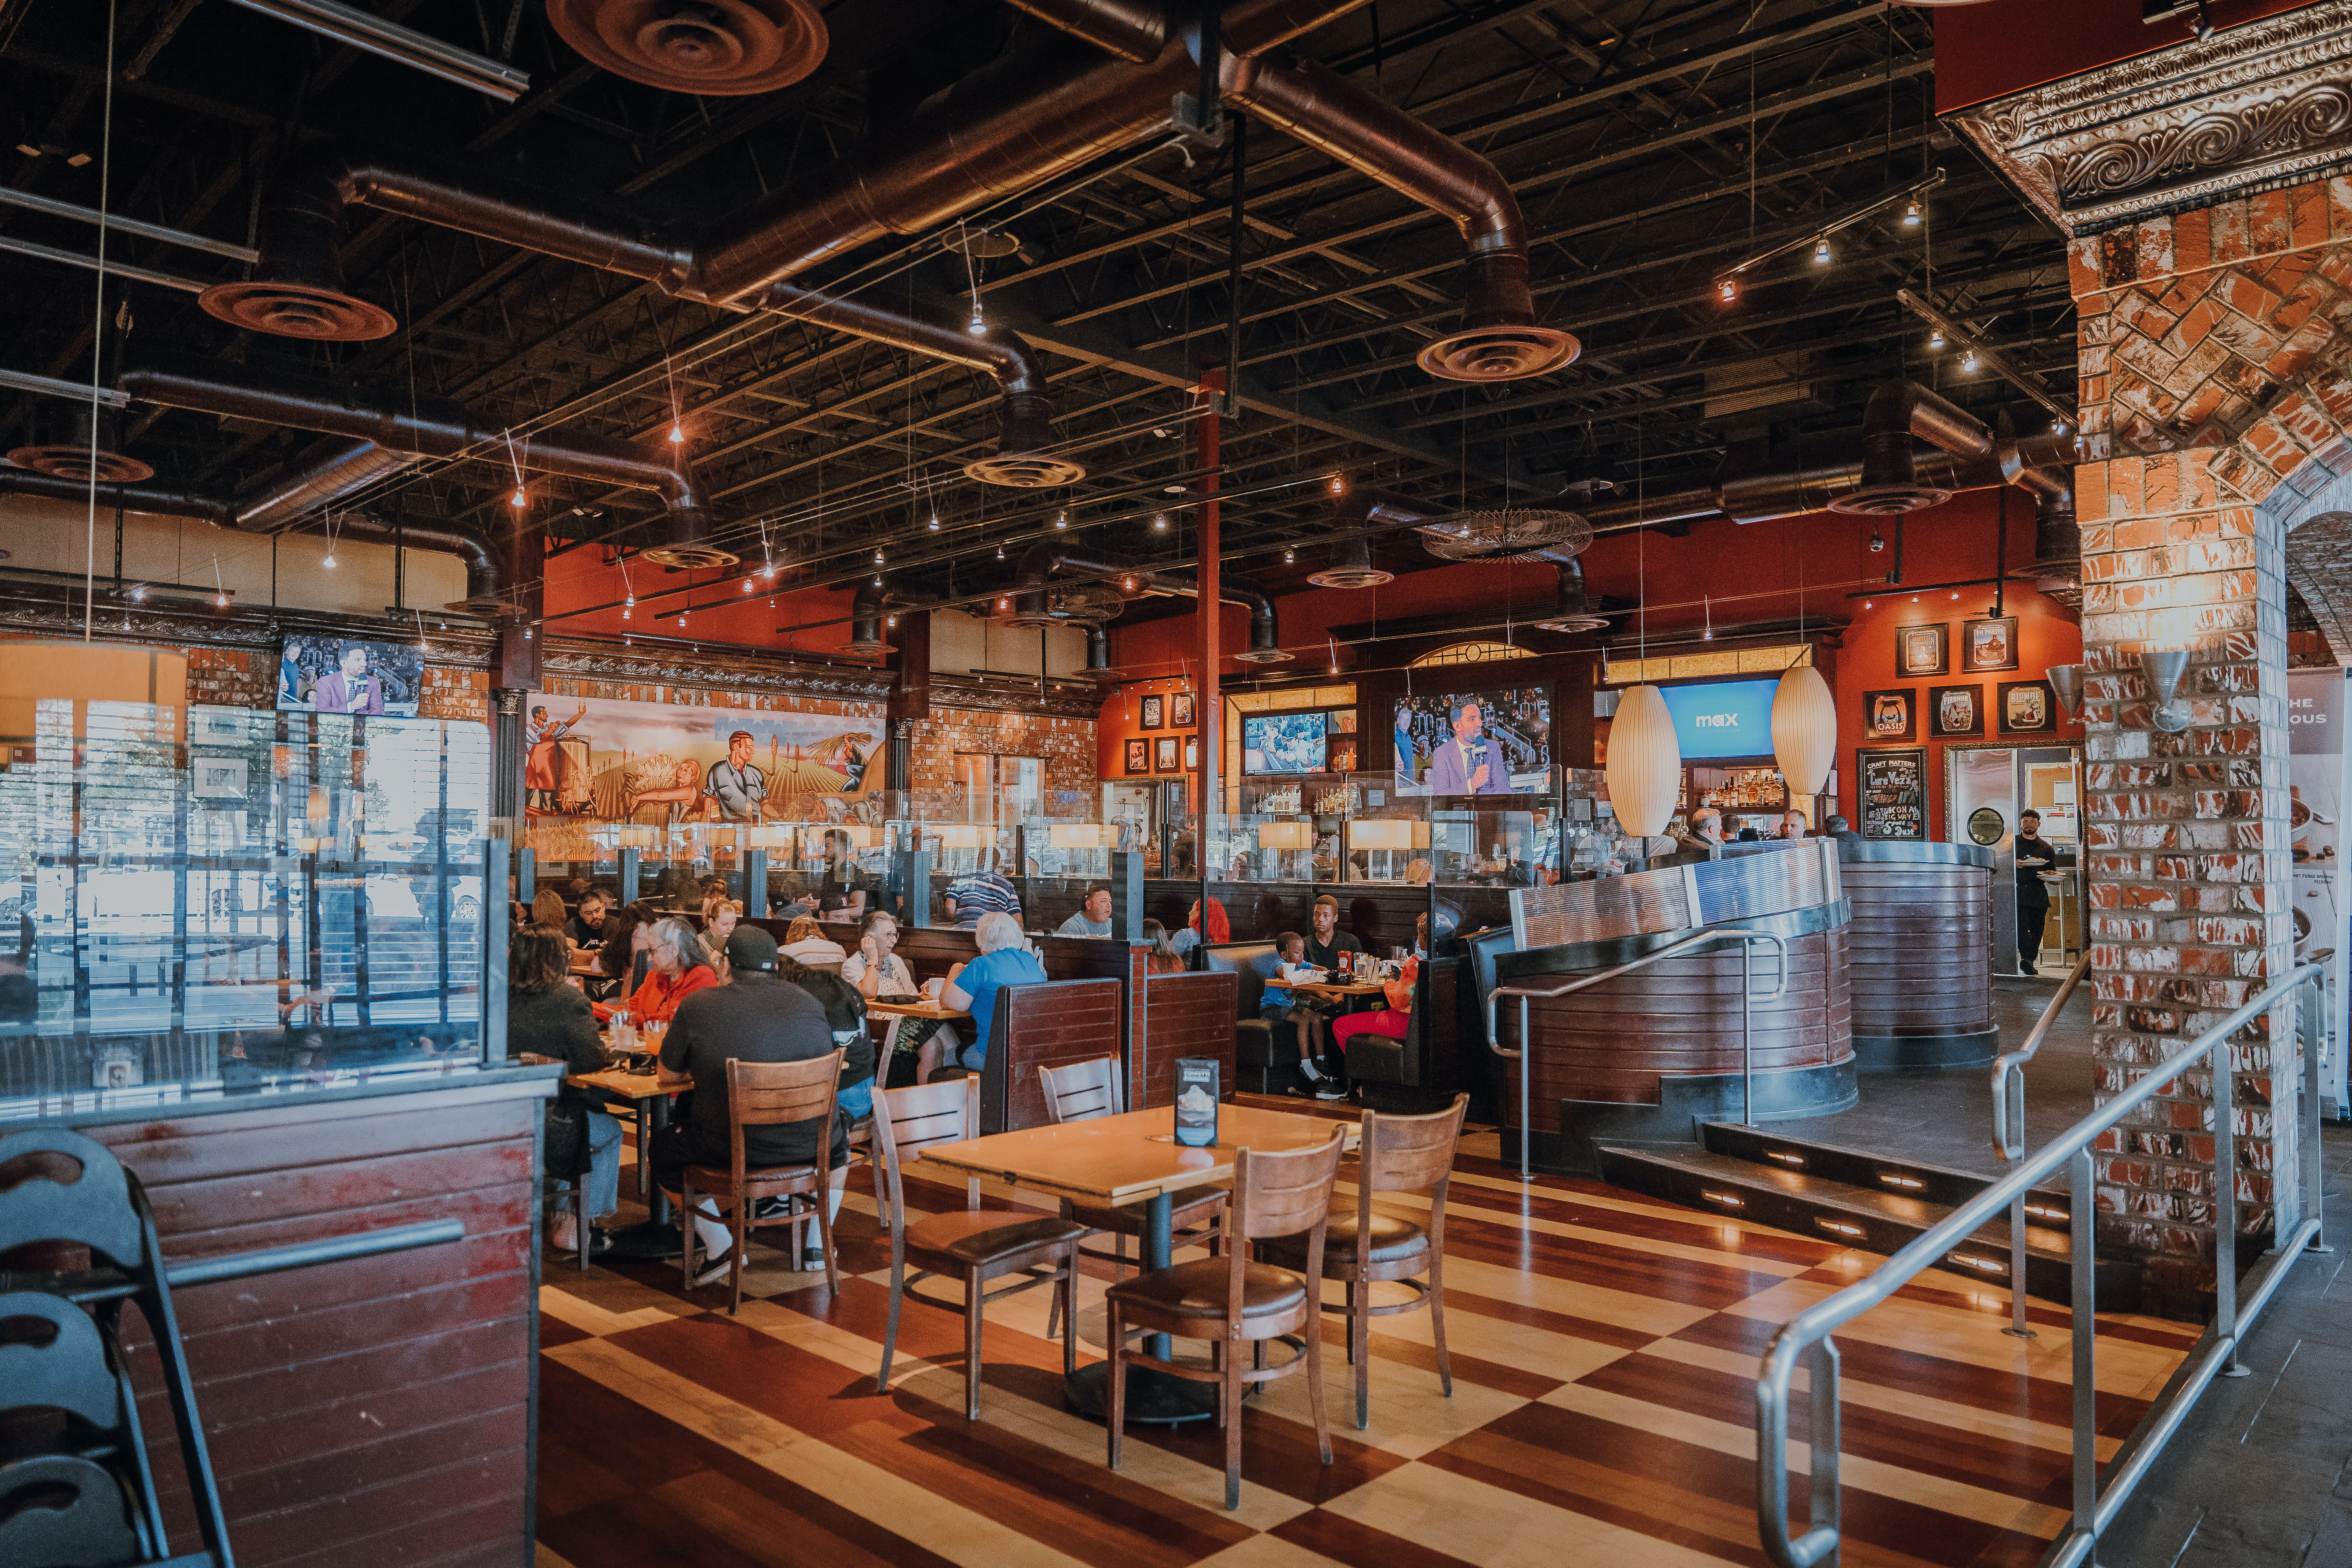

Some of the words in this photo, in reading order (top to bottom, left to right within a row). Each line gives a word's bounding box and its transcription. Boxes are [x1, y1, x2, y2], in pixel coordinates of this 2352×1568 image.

[1944, 696, 1968, 705] PIRANHA
[2011, 692, 2041, 703] BLONDE
[1696, 713, 1739, 727] max
[2289, 714, 2327, 724] OUS
[1898, 791, 1916, 804] IPA
[1883, 821, 1906, 835] Space
